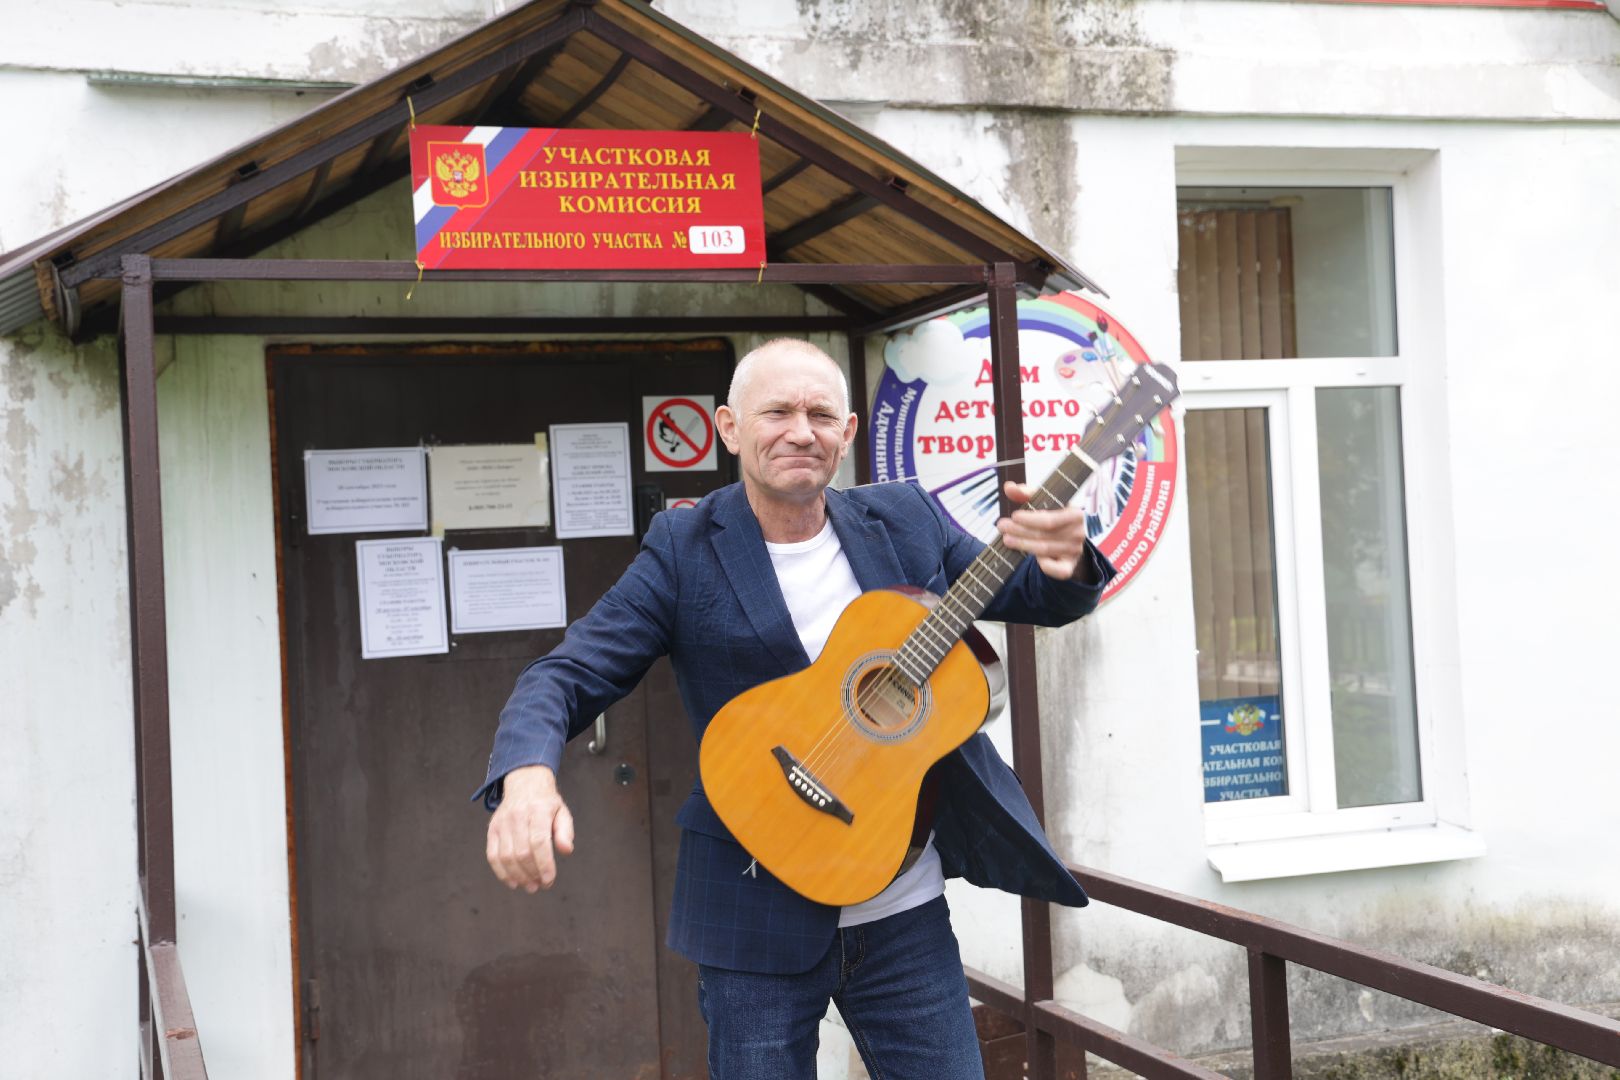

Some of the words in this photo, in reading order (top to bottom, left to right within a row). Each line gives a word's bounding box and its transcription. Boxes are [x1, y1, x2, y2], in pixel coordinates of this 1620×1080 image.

[542, 146, 711, 167] УЧАСТКОВАЯ
[519, 171, 736, 190] ИЗБИРАТЕЛЬНАЯ
[559, 195, 702, 214] КОМИССИЯ
[439, 231, 586, 250] ИЗБИРАТЕЛЬНОГО
[593, 231, 663, 250] УЧАСТКА
[700, 229, 734, 248] 103
[975, 358, 1039, 387] Дм
[1144, 480, 1171, 544] района
